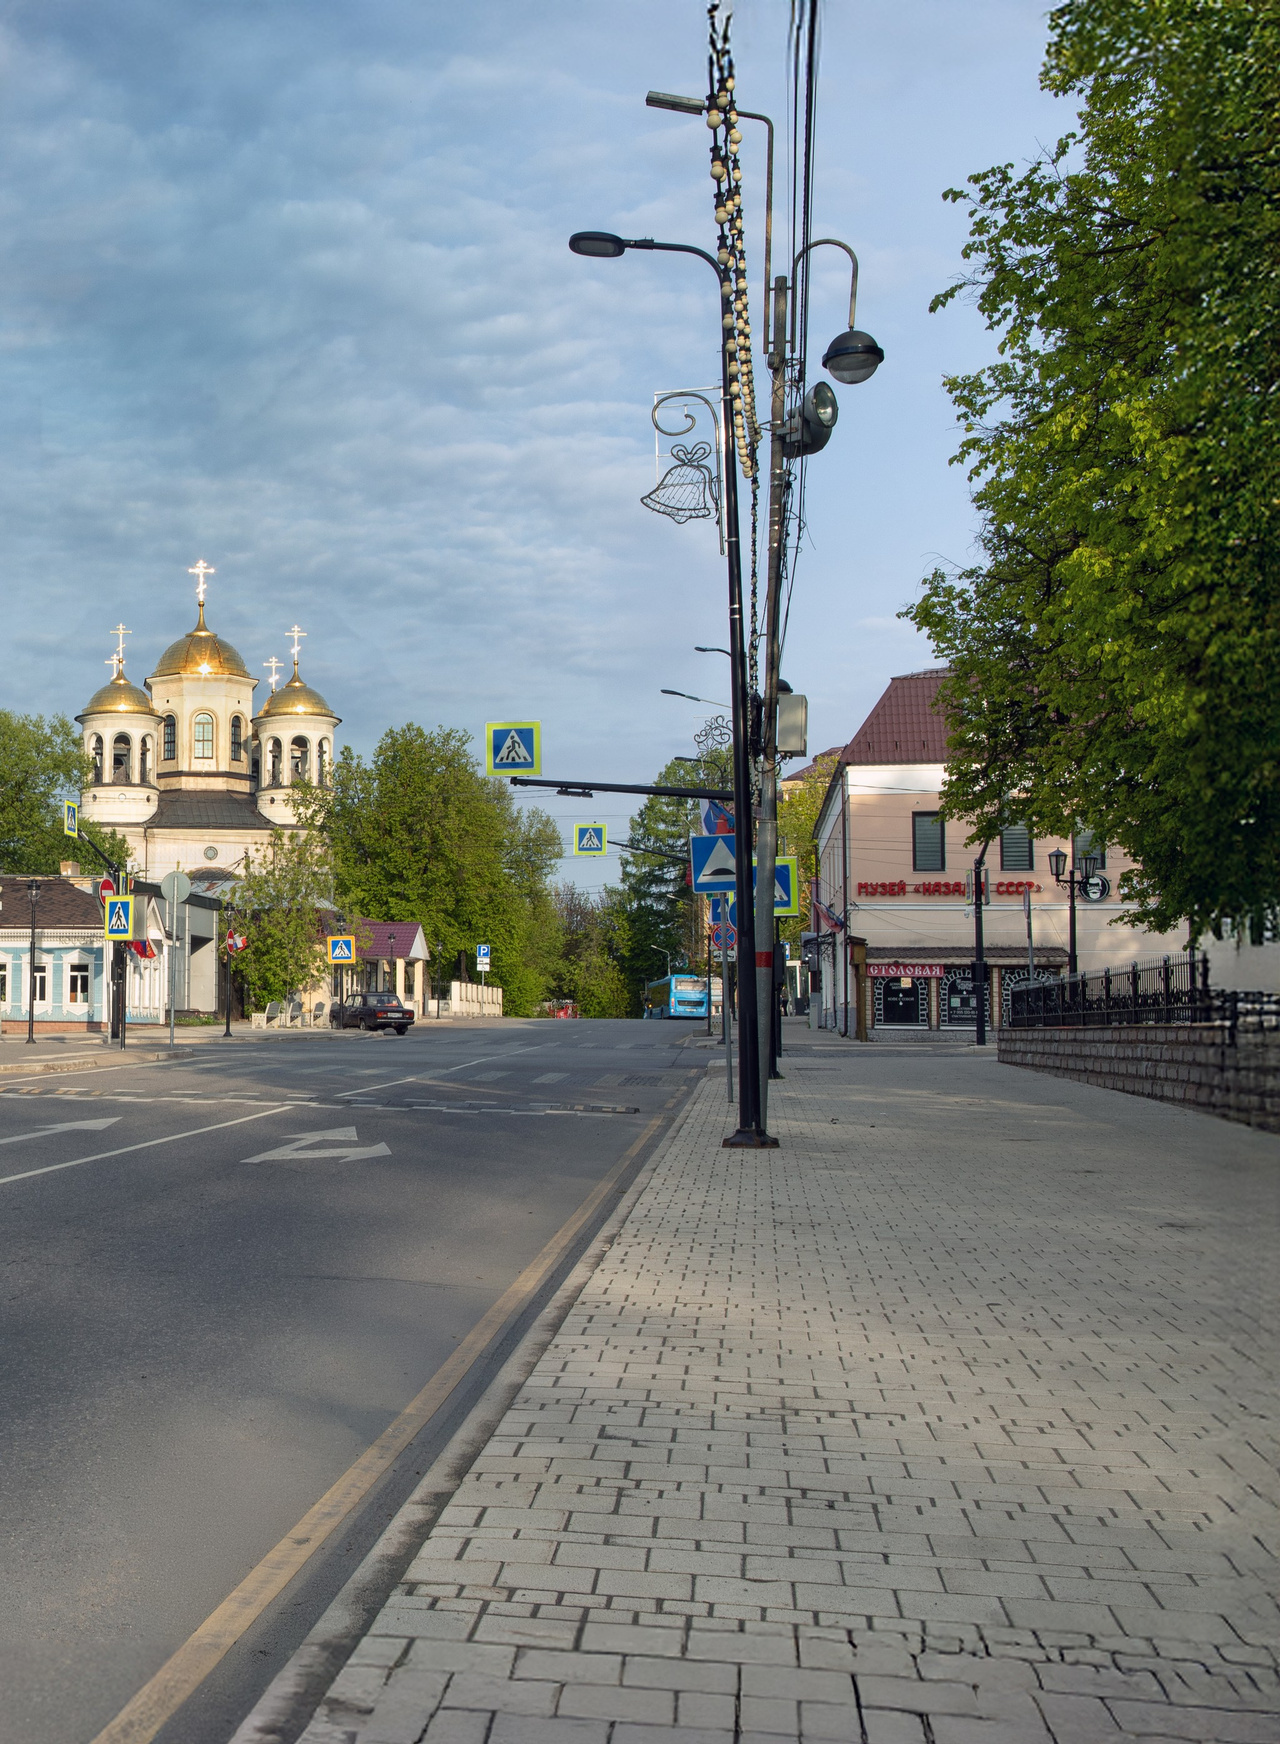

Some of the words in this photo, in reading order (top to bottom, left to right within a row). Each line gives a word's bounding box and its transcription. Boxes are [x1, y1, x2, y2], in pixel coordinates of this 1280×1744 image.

[858, 880, 906, 896] МУЗЕЙ
[480, 946, 488, 956] P
[869, 965, 941, 975] СТОЛОВАЯ
